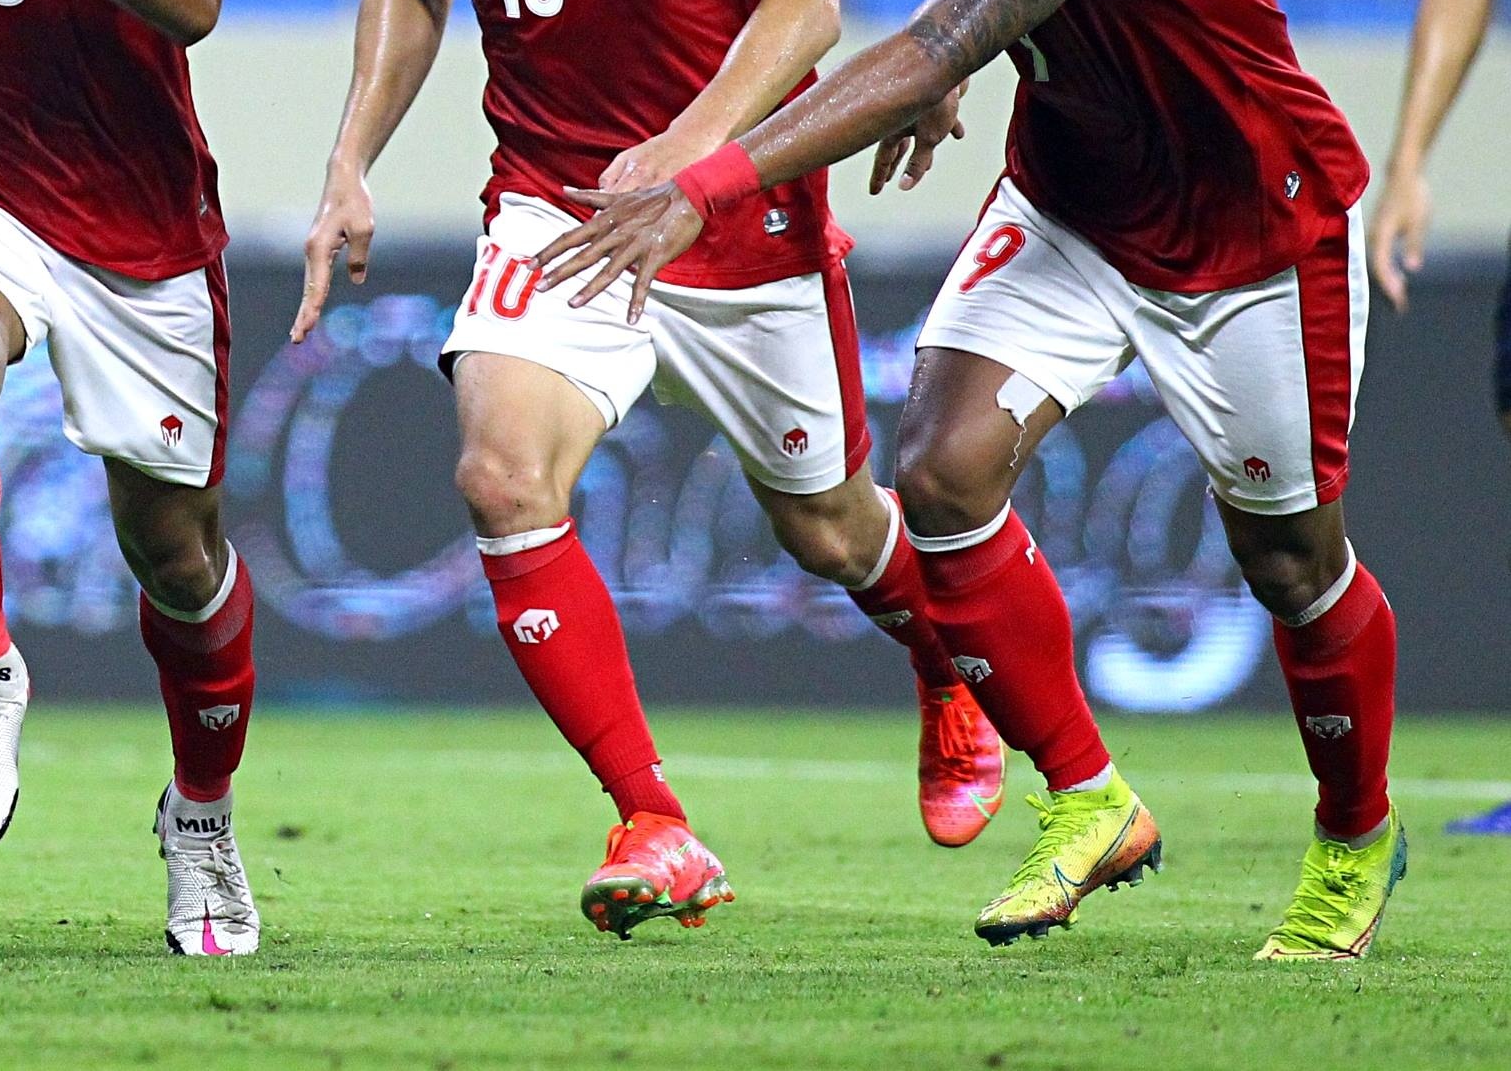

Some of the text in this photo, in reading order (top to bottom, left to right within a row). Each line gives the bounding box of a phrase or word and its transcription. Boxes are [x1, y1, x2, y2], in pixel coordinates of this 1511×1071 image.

[467, 242, 545, 321] 10
[958, 222, 1026, 295] 9
[175, 811, 232, 833] MIL
